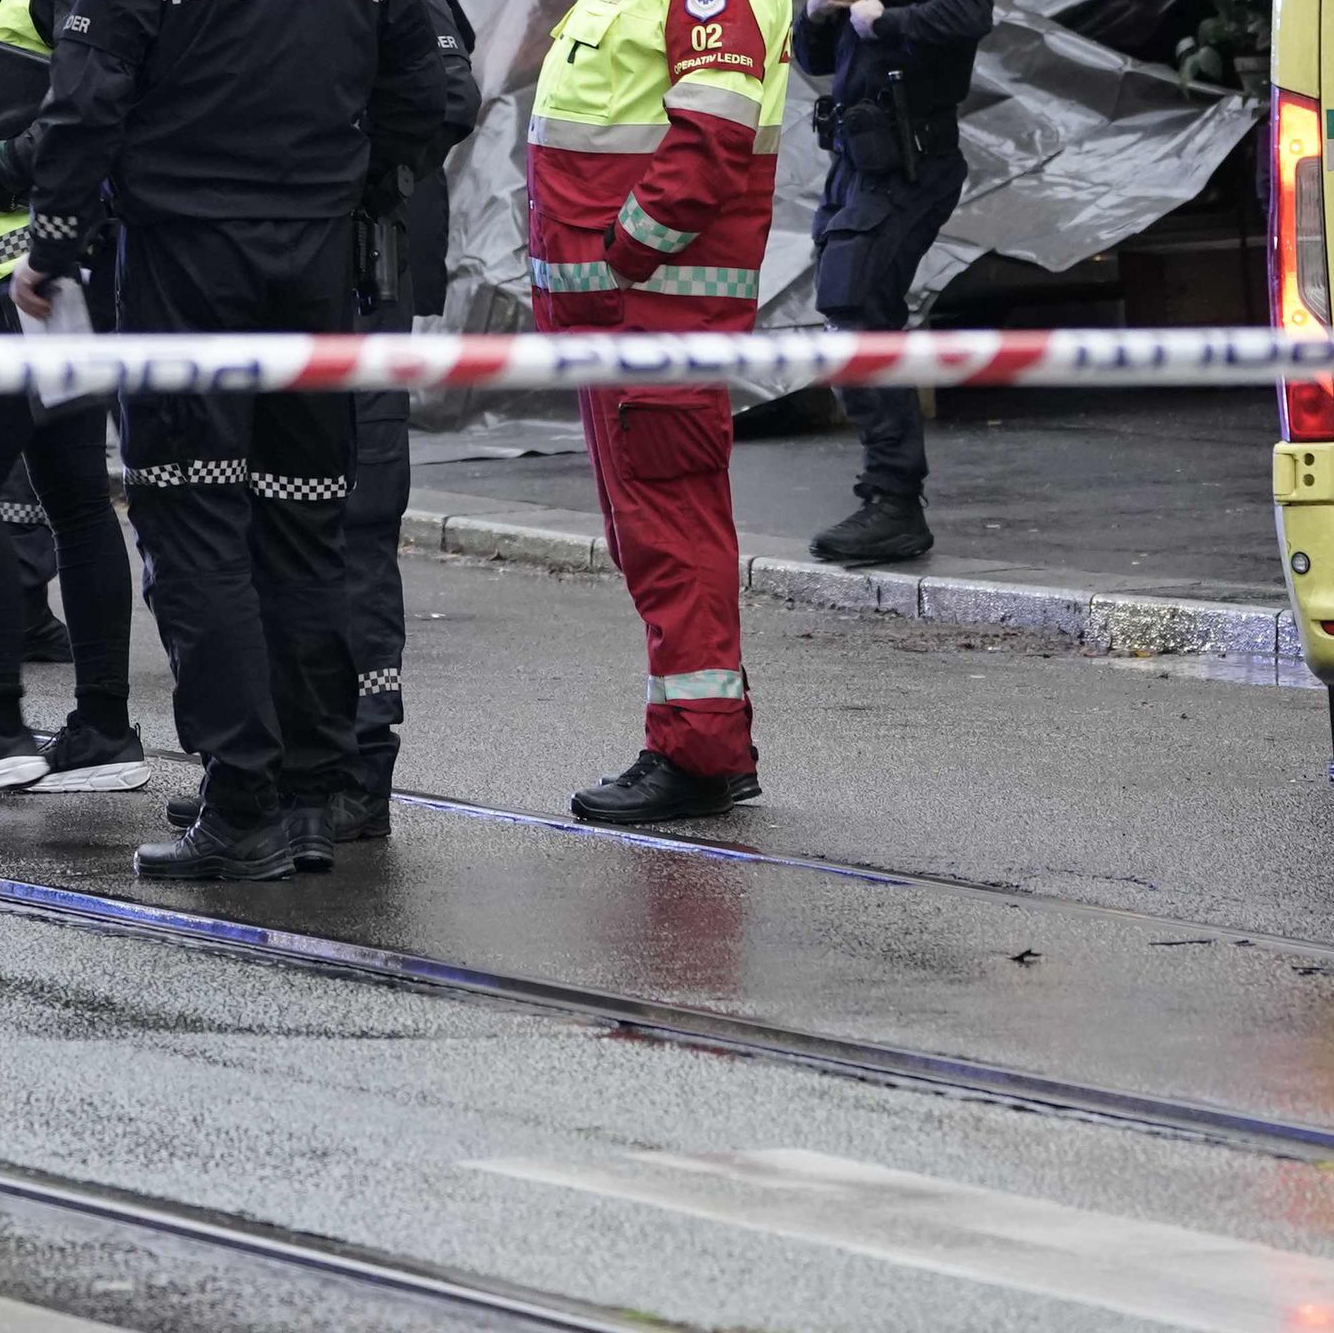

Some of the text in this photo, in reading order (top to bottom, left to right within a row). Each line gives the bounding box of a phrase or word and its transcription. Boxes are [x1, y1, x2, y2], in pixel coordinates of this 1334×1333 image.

[691, 23, 723, 52] 02
[674, 52, 754, 75] OPERATIV LEDER
